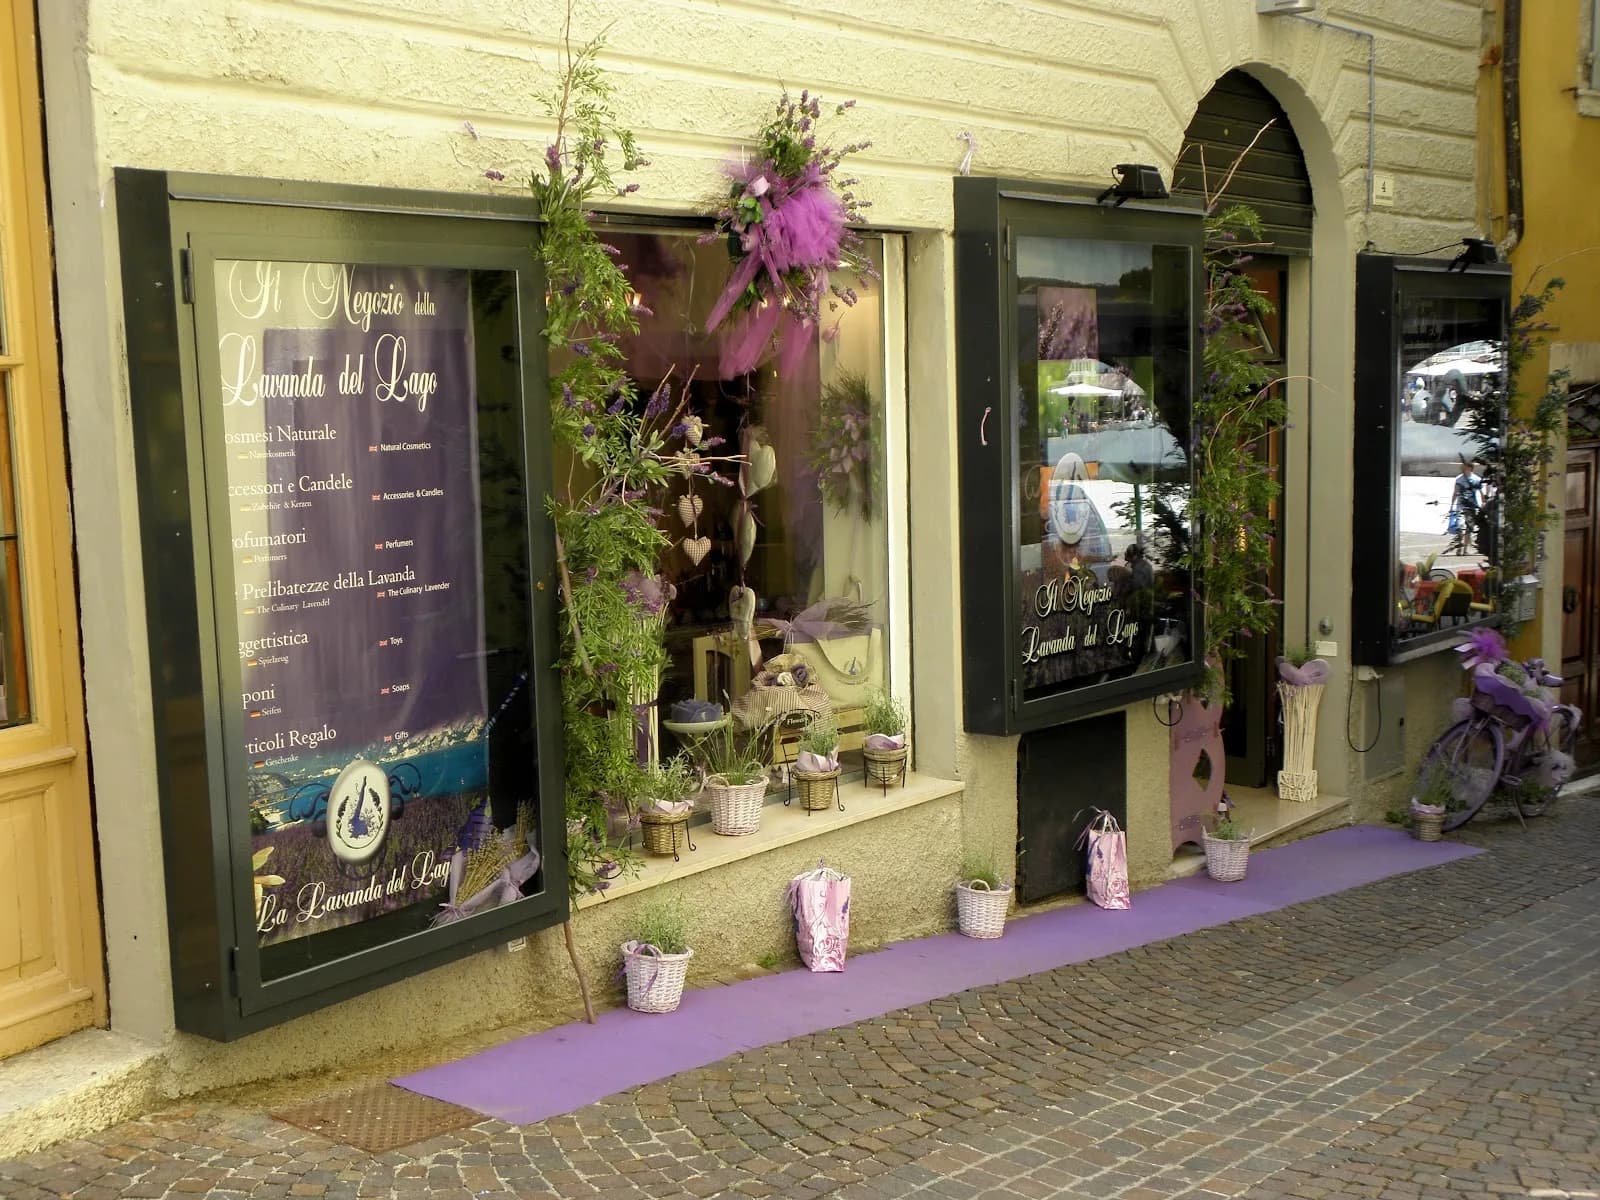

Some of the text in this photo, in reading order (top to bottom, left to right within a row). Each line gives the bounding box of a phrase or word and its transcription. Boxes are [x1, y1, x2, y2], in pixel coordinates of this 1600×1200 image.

[303, 262, 403, 332] Negozio
[415, 292, 436, 315] della
[219, 332, 437, 412] Lavanda del Lago
[277, 424, 337, 441] Naturale
[380, 442, 431, 451] Natural Cosmetics
[288, 482, 295, 492] e
[299, 473, 353, 492] Candele
[383, 491, 414, 500] Accessories
[421, 488, 444, 497] Candles
[284, 501, 289, 509] &
[232, 528, 306, 548] ofumatori
[385, 540, 413, 549] Perfumers
[242, 565, 415, 600] Prelibatezze della Lavanda
[388, 581, 450, 597] The Culinary Lavender
[1035, 575, 1112, 617] Il Negozio
[256, 598, 330, 614] The Culinary Lavendel
[390, 637, 403, 645] Toys
[1022, 609, 1138, 665] Lavanda del Lago
[242, 684, 275, 709] poni
[392, 683, 410, 693] Soaps
[245, 724, 337, 754] ticoli Regalo
[394, 731, 409, 740] Gifts
[257, 850, 450, 932] La Lavanda del Lag
